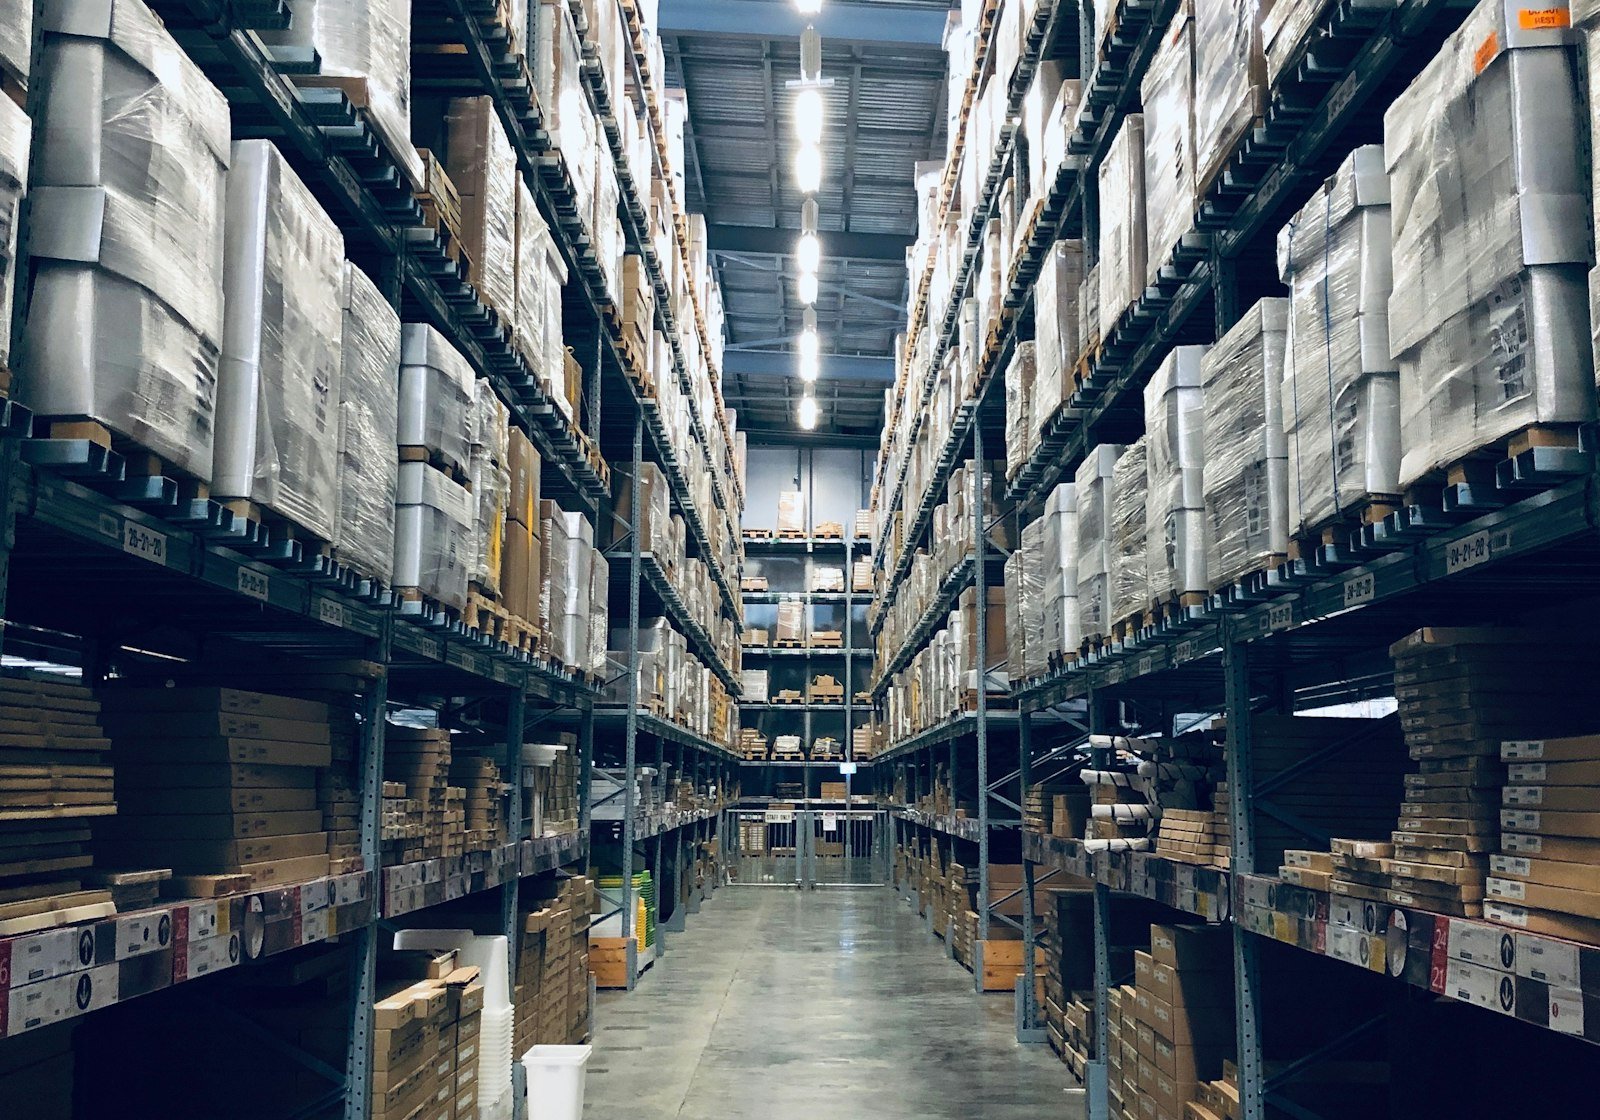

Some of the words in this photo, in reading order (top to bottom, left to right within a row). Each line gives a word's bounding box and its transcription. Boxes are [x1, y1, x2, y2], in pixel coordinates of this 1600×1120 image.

[1451, 537, 1485, 567] 24-21-20
[1433, 928, 1447, 950] 24
[1431, 966, 1444, 989] 21
